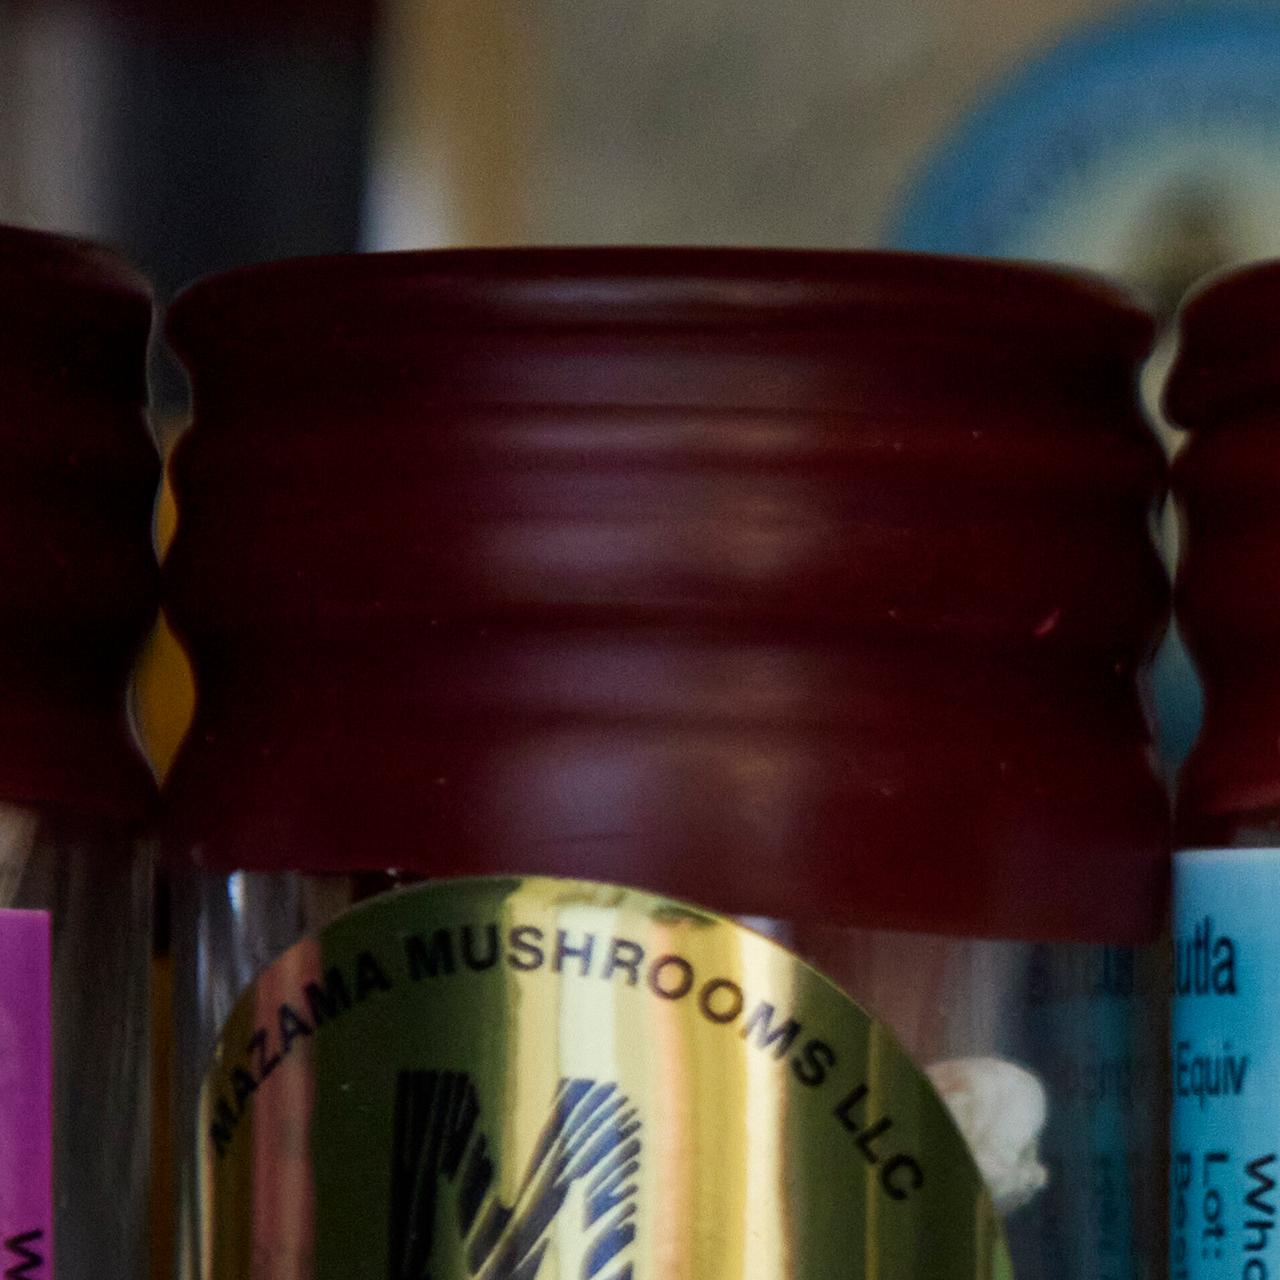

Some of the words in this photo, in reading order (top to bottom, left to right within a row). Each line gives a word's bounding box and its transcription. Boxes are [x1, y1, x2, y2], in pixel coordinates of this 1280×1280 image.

[208, 962, 395, 1159] MAZAMA
[405, 921, 837, 1088] MUSHROOMS
[832, 1084, 927, 1201] LLC
[1175, 1039, 1248, 1113] Equiv
[1200, 1151, 1233, 1261] Lot:
